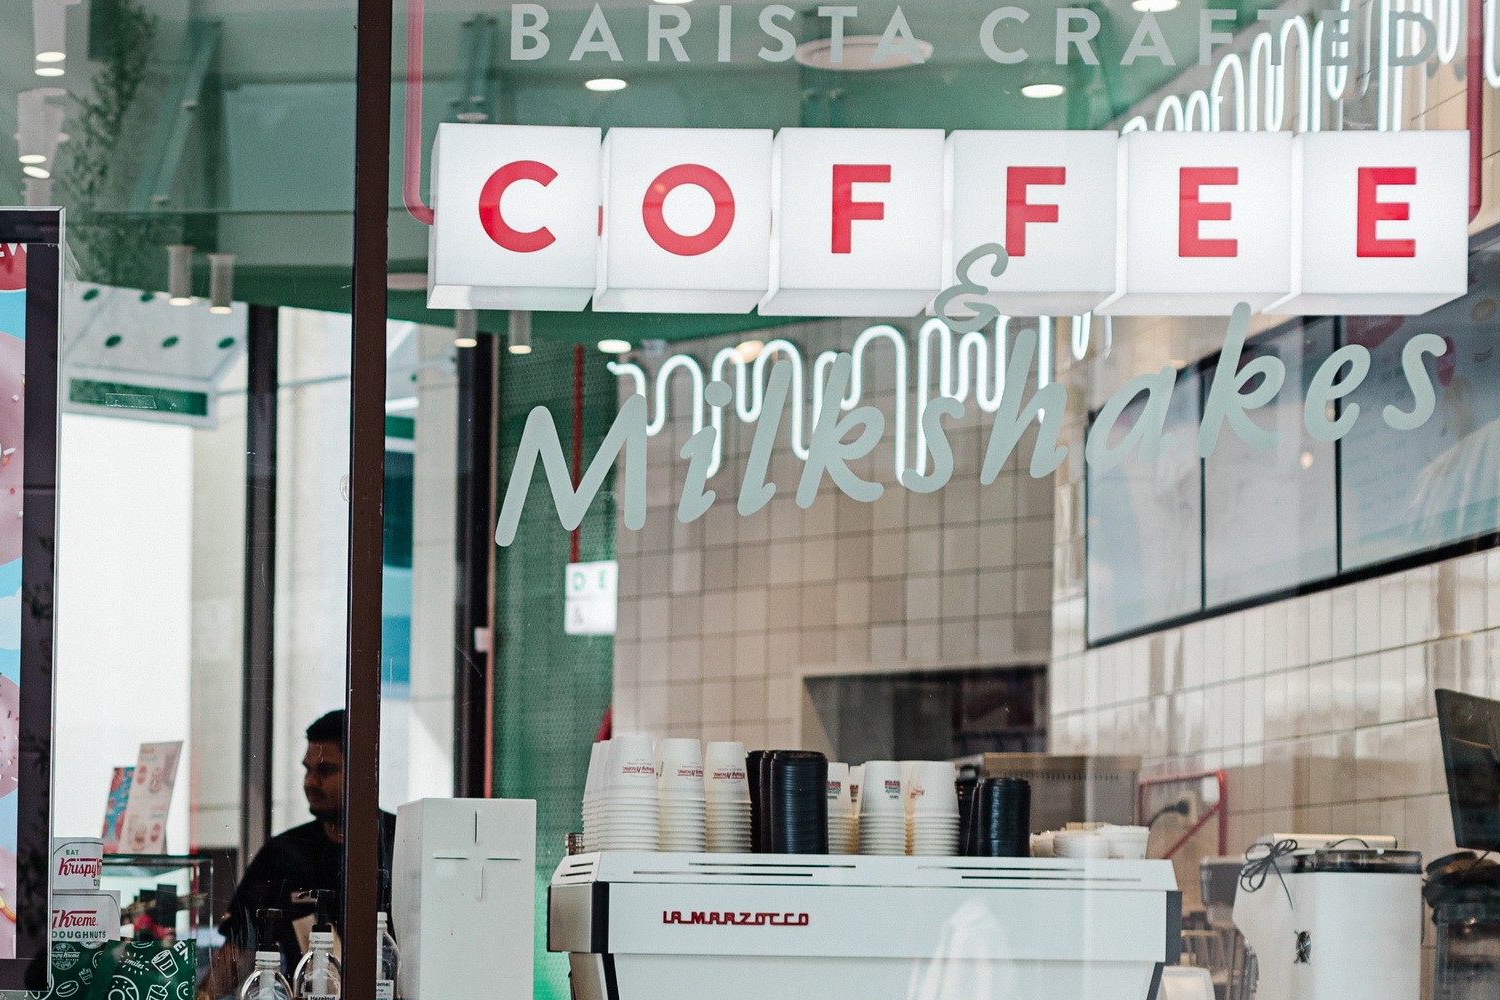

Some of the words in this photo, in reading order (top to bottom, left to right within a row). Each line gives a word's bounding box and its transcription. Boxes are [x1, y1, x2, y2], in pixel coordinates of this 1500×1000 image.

[510, 4, 925, 64] BARISTA
[978, 6, 1438, 67] CRAFTED
[478, 160, 1418, 258] COFFEE
[934, 242, 1009, 334] &
[494, 302, 1448, 549] Milkshakes
[58, 858, 97, 878] Krispy
[58, 909, 98, 928] Kreme
[663, 911, 682, 924] LA
[691, 911, 809, 926] MARZOCCO
[52, 931, 107, 939] DOUGHNUTS
[124, 958, 145, 970] smiles
